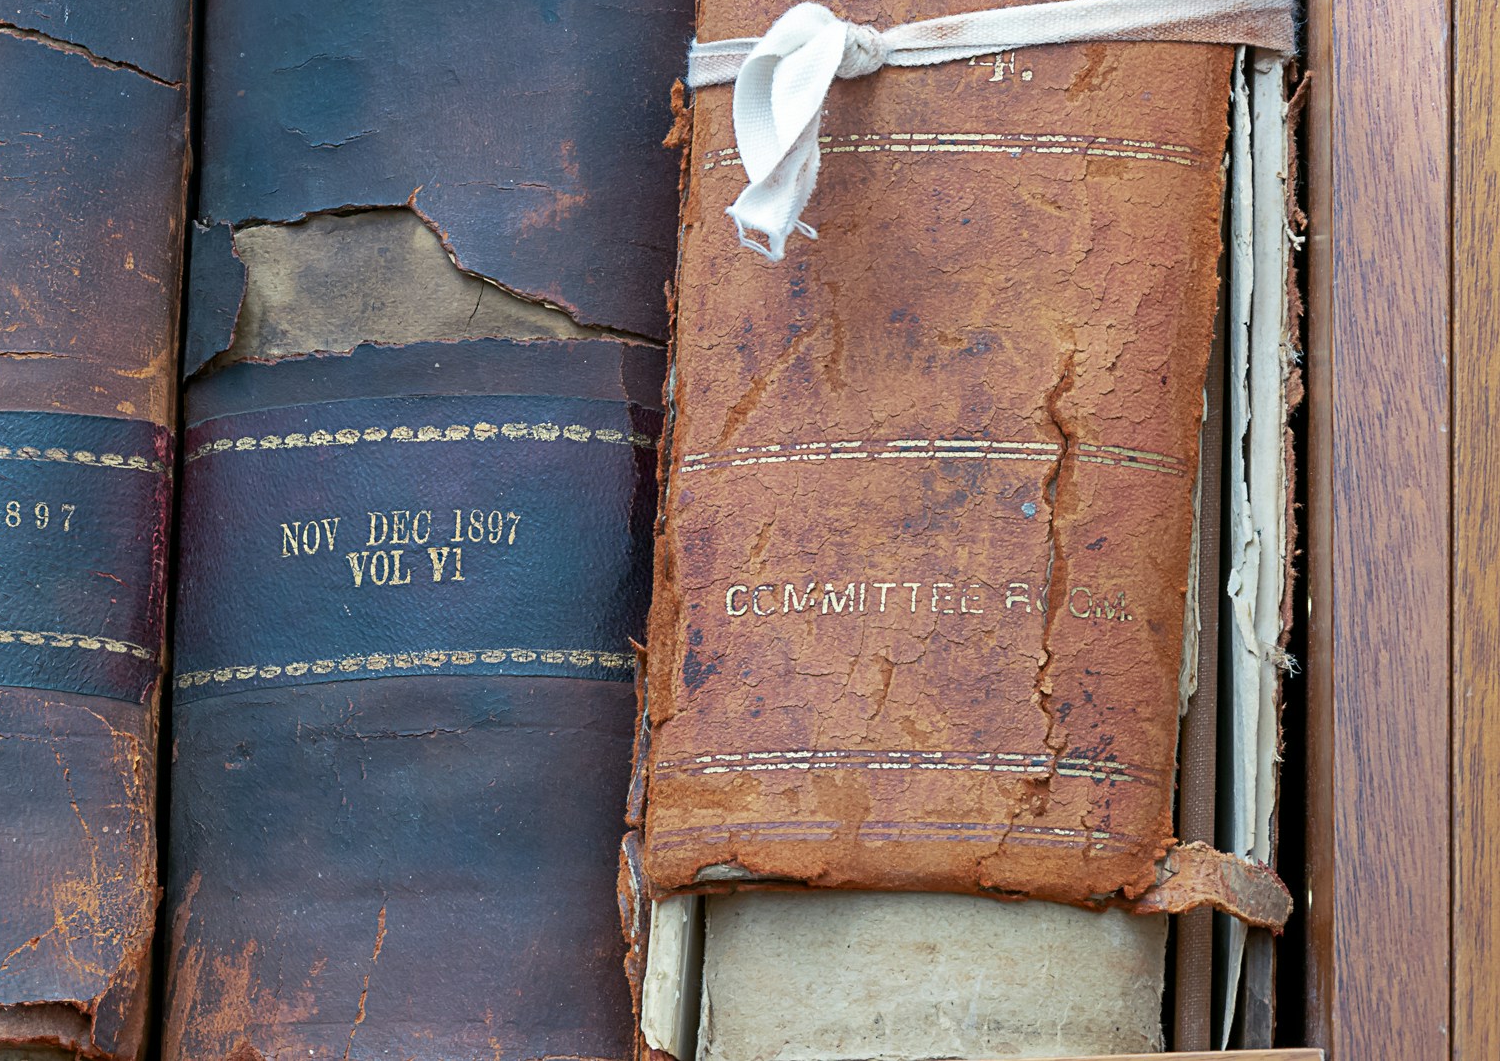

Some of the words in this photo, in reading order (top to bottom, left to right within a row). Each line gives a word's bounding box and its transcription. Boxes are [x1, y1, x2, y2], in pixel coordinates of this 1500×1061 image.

[280, 517, 341, 558] NOV
[366, 509, 432, 547] DEC
[450, 508, 521, 546] 1897
[345, 549, 411, 588] VOL
[725, 581, 984, 617] COMMITTEE
